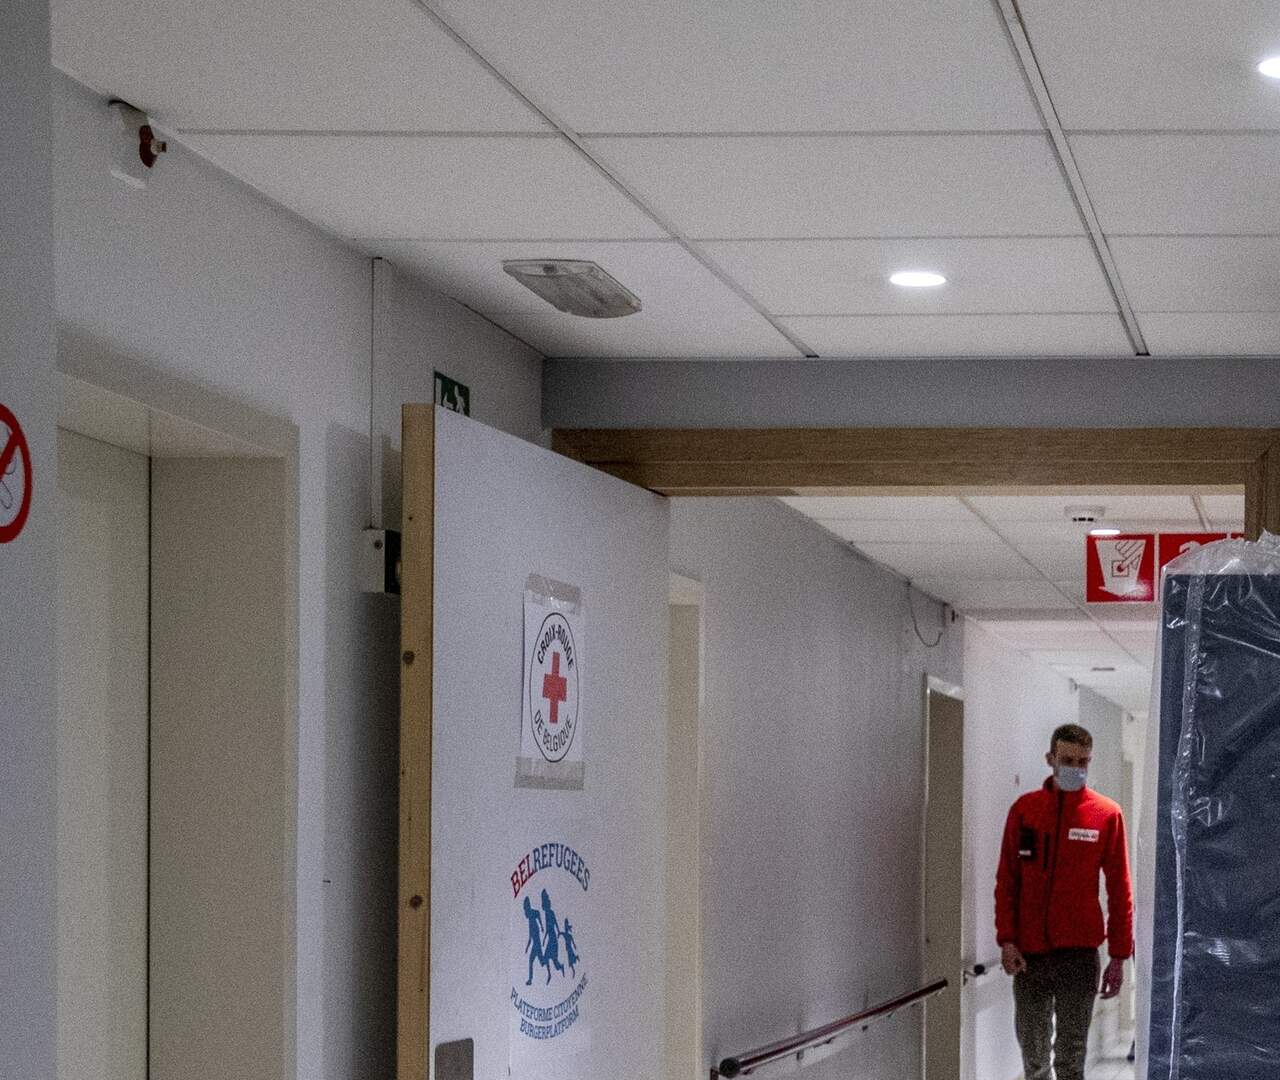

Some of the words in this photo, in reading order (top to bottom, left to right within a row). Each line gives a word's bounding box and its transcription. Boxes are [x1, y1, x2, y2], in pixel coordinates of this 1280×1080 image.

[537, 624, 574, 671] CROIX-ROUGE
[534, 709, 544, 735] DE
[543, 714, 572, 752] BELGIQUE
[510, 843, 590, 899] BELREFUGEES
[510, 986, 554, 1022] PLATEFORME
[553, 972, 590, 1019] CITOYENNE
[519, 1005, 580, 1040] BURGERPLATFORM
